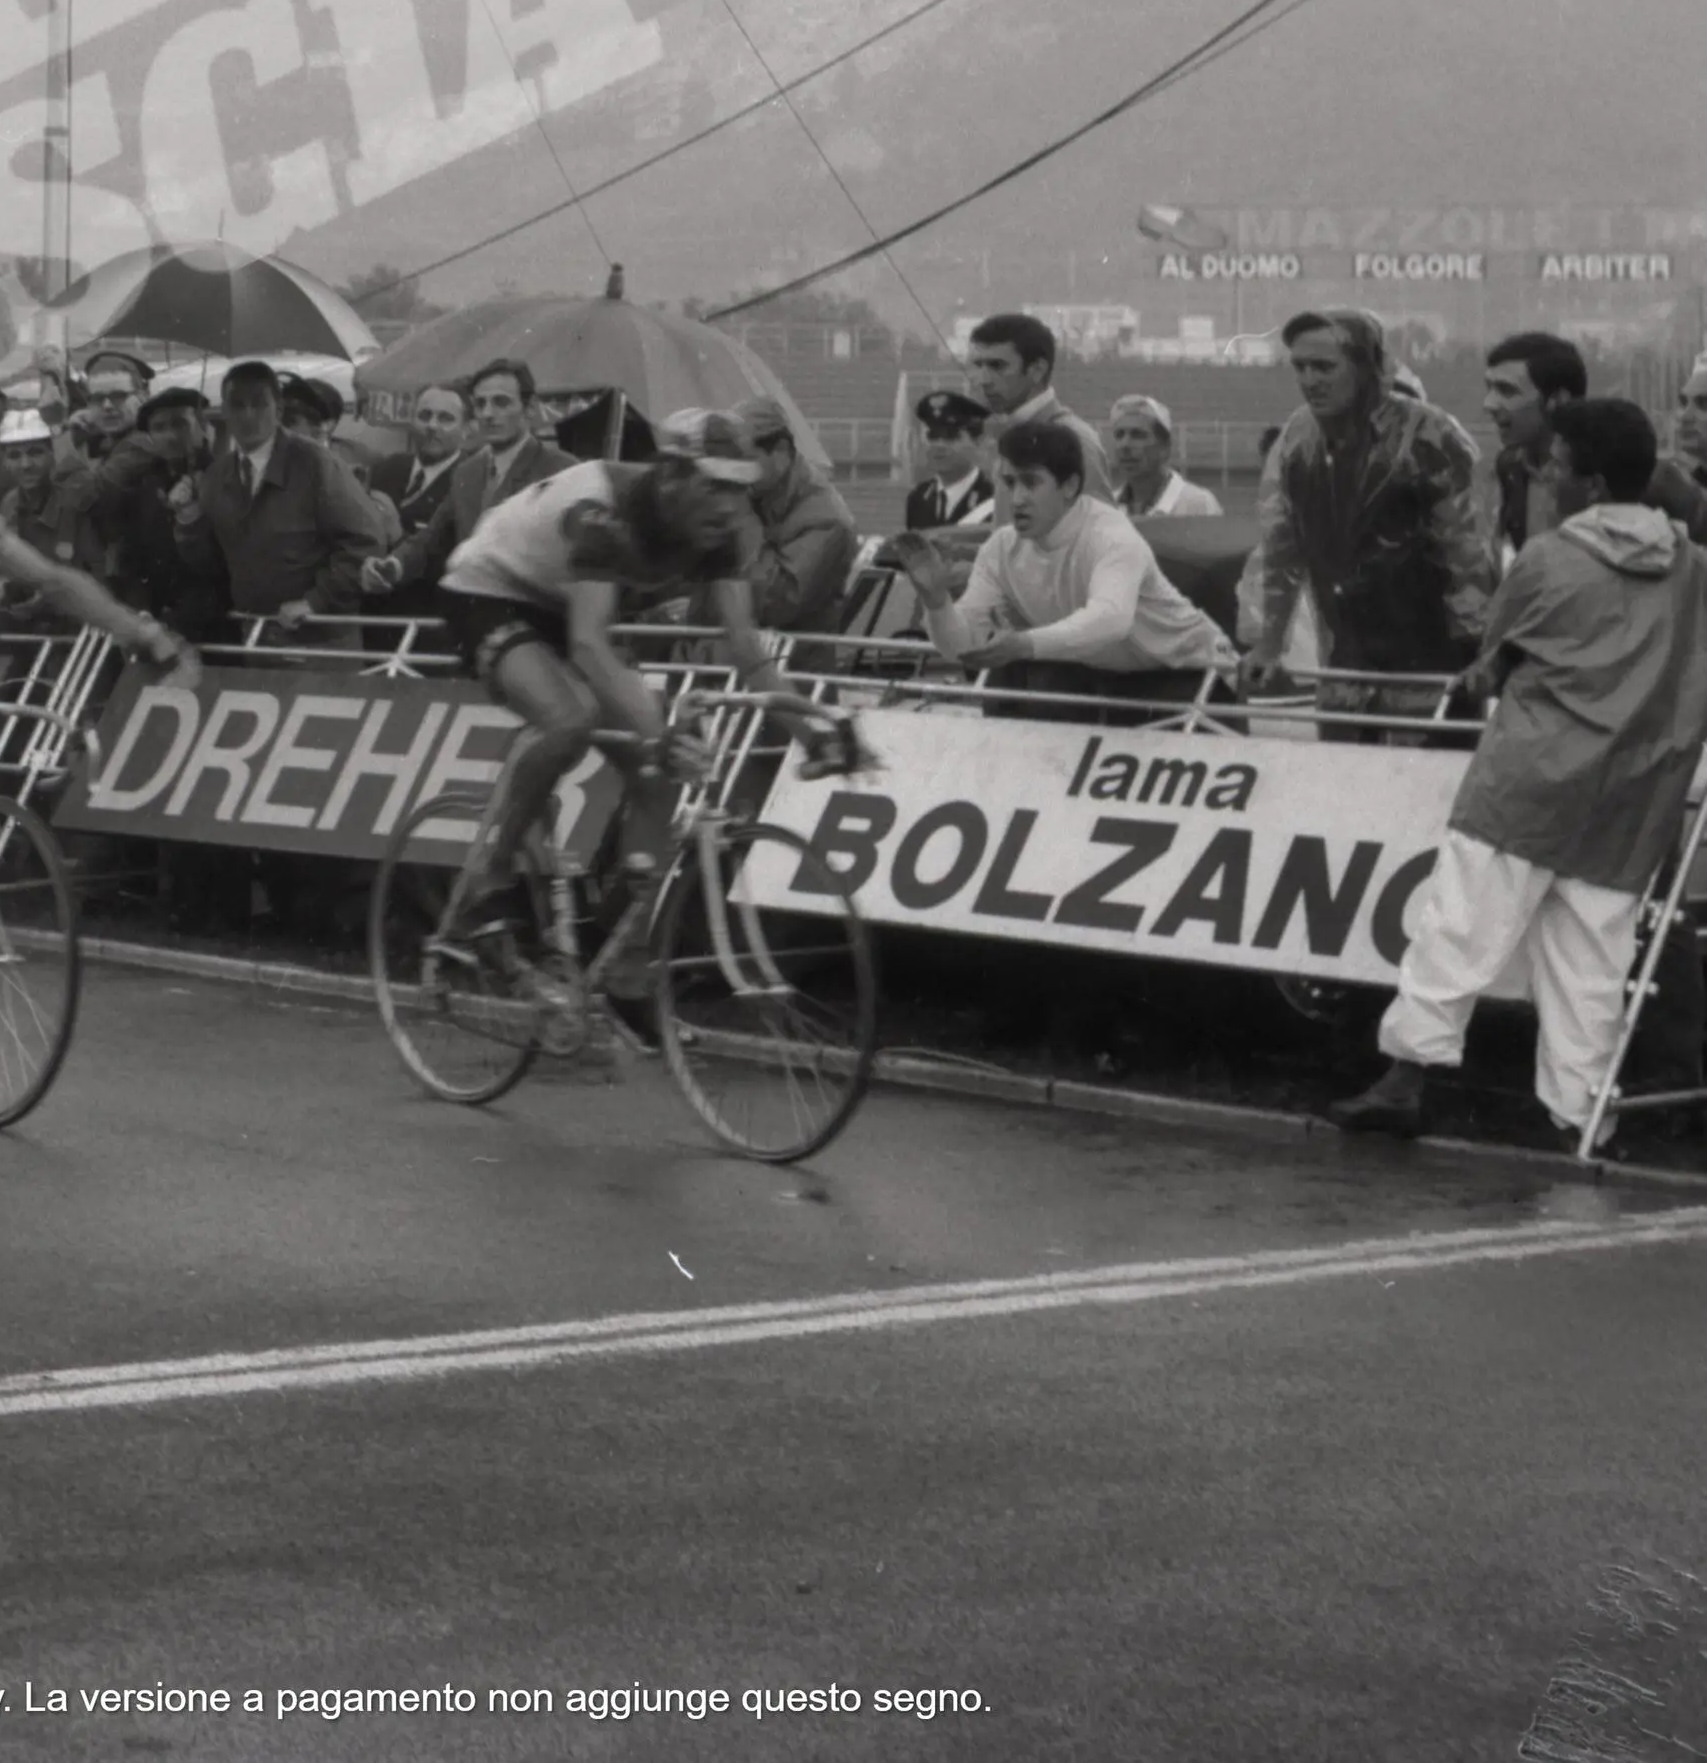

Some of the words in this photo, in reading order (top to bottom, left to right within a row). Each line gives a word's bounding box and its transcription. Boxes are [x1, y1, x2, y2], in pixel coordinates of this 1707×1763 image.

[1160, 254, 1193, 279] AL
[1201, 255, 1300, 279] DUOMO
[1355, 254, 1484, 279] FOLGORE
[1540, 255, 1671, 279] ARBITER
[1066, 736, 1259, 812] lama
